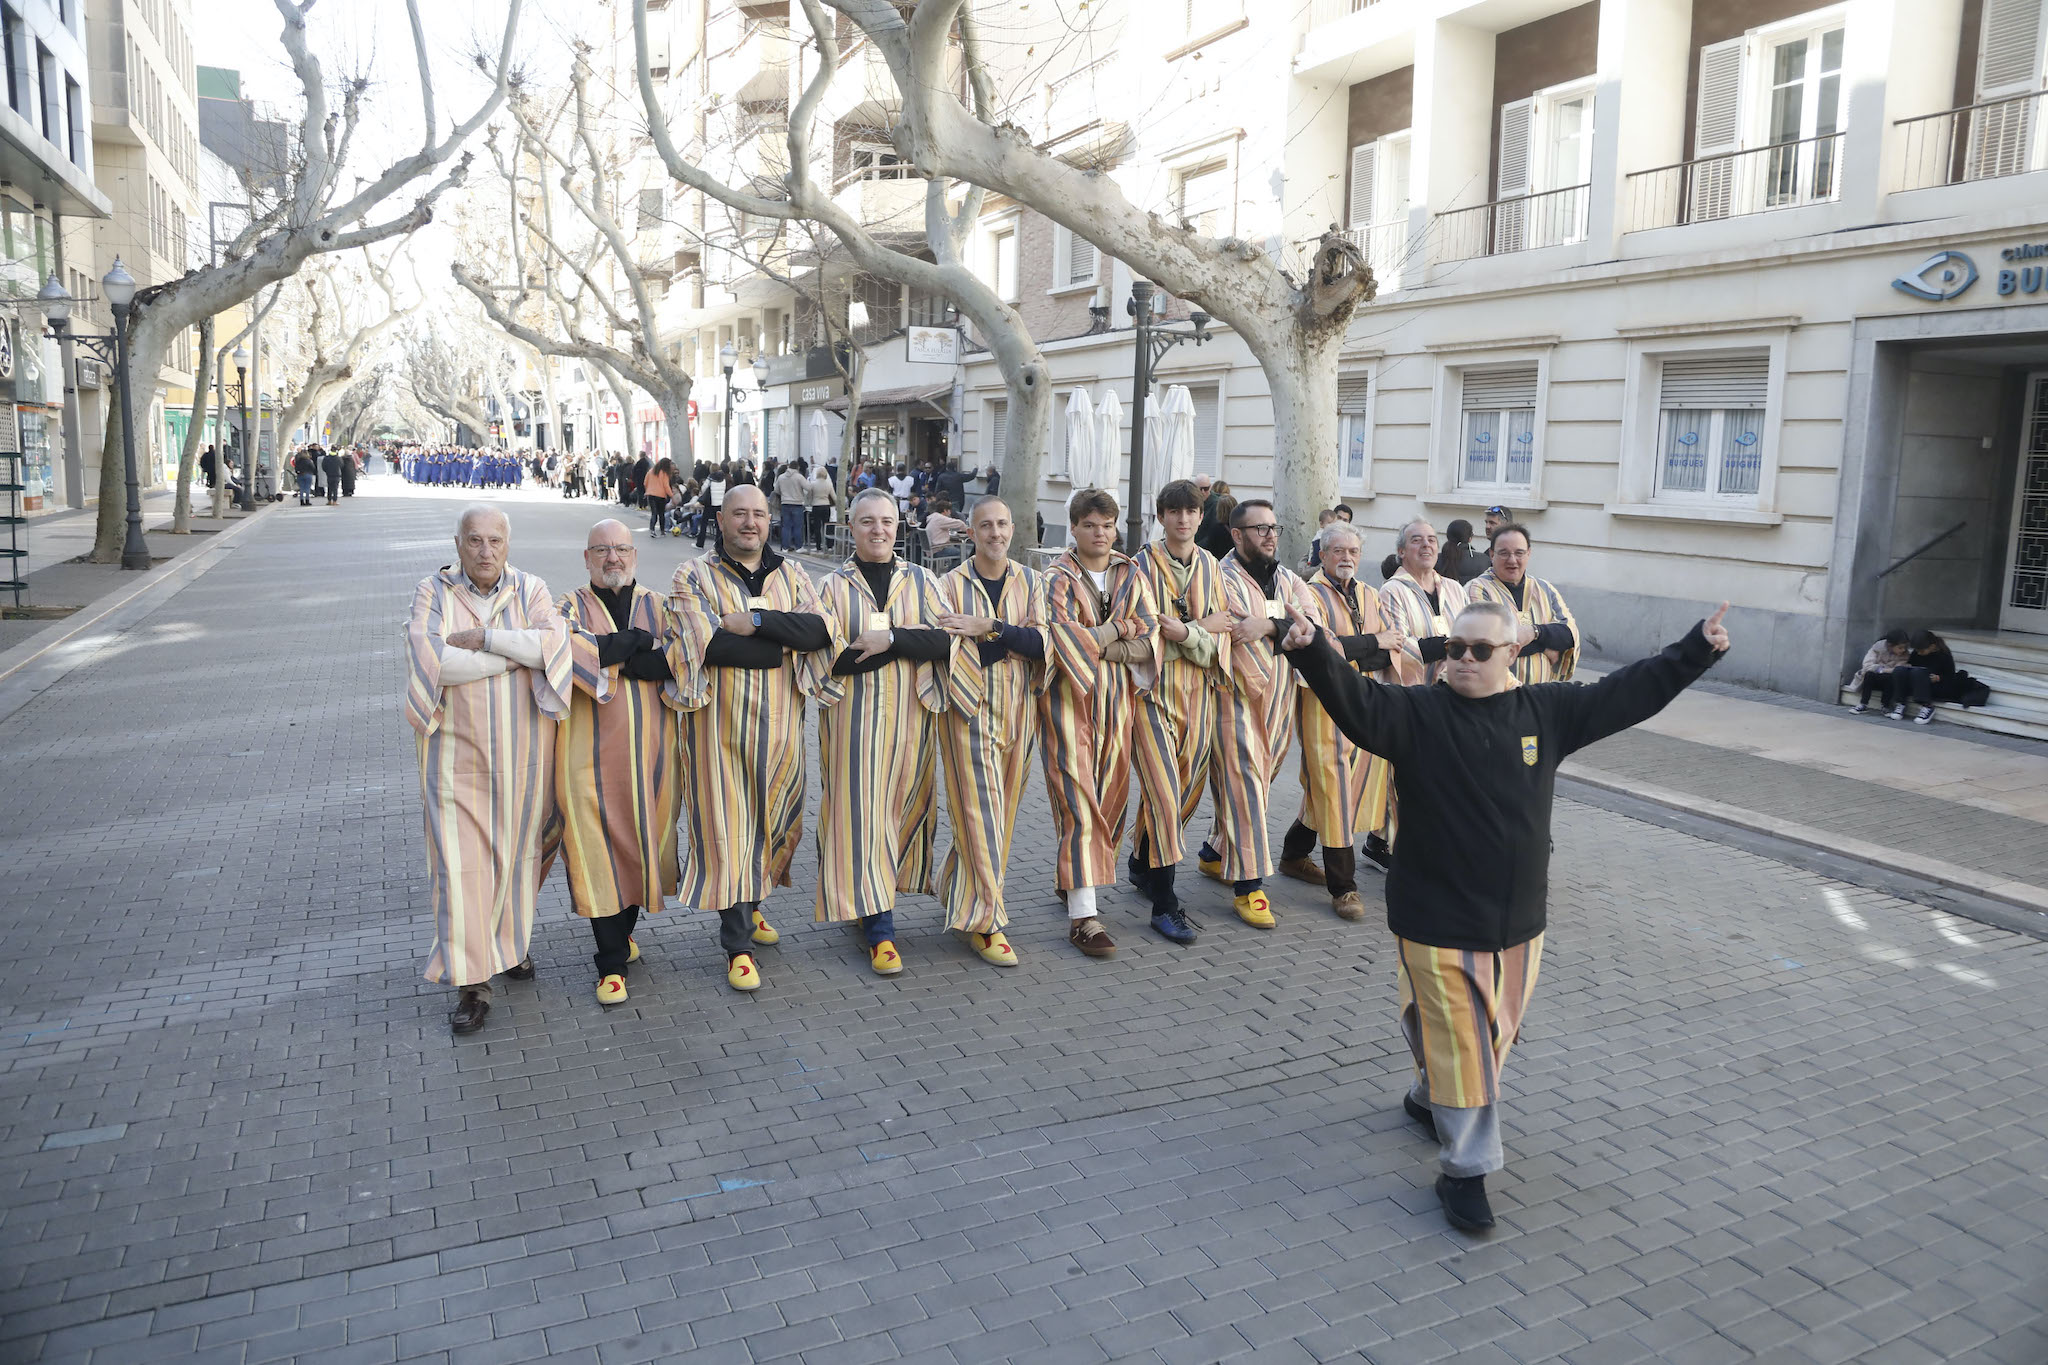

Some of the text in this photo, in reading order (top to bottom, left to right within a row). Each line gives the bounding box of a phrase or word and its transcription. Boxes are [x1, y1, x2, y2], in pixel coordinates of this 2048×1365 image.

[802, 385, 830, 401] casa viva
[1669, 459, 1704, 468] BUIGUES
